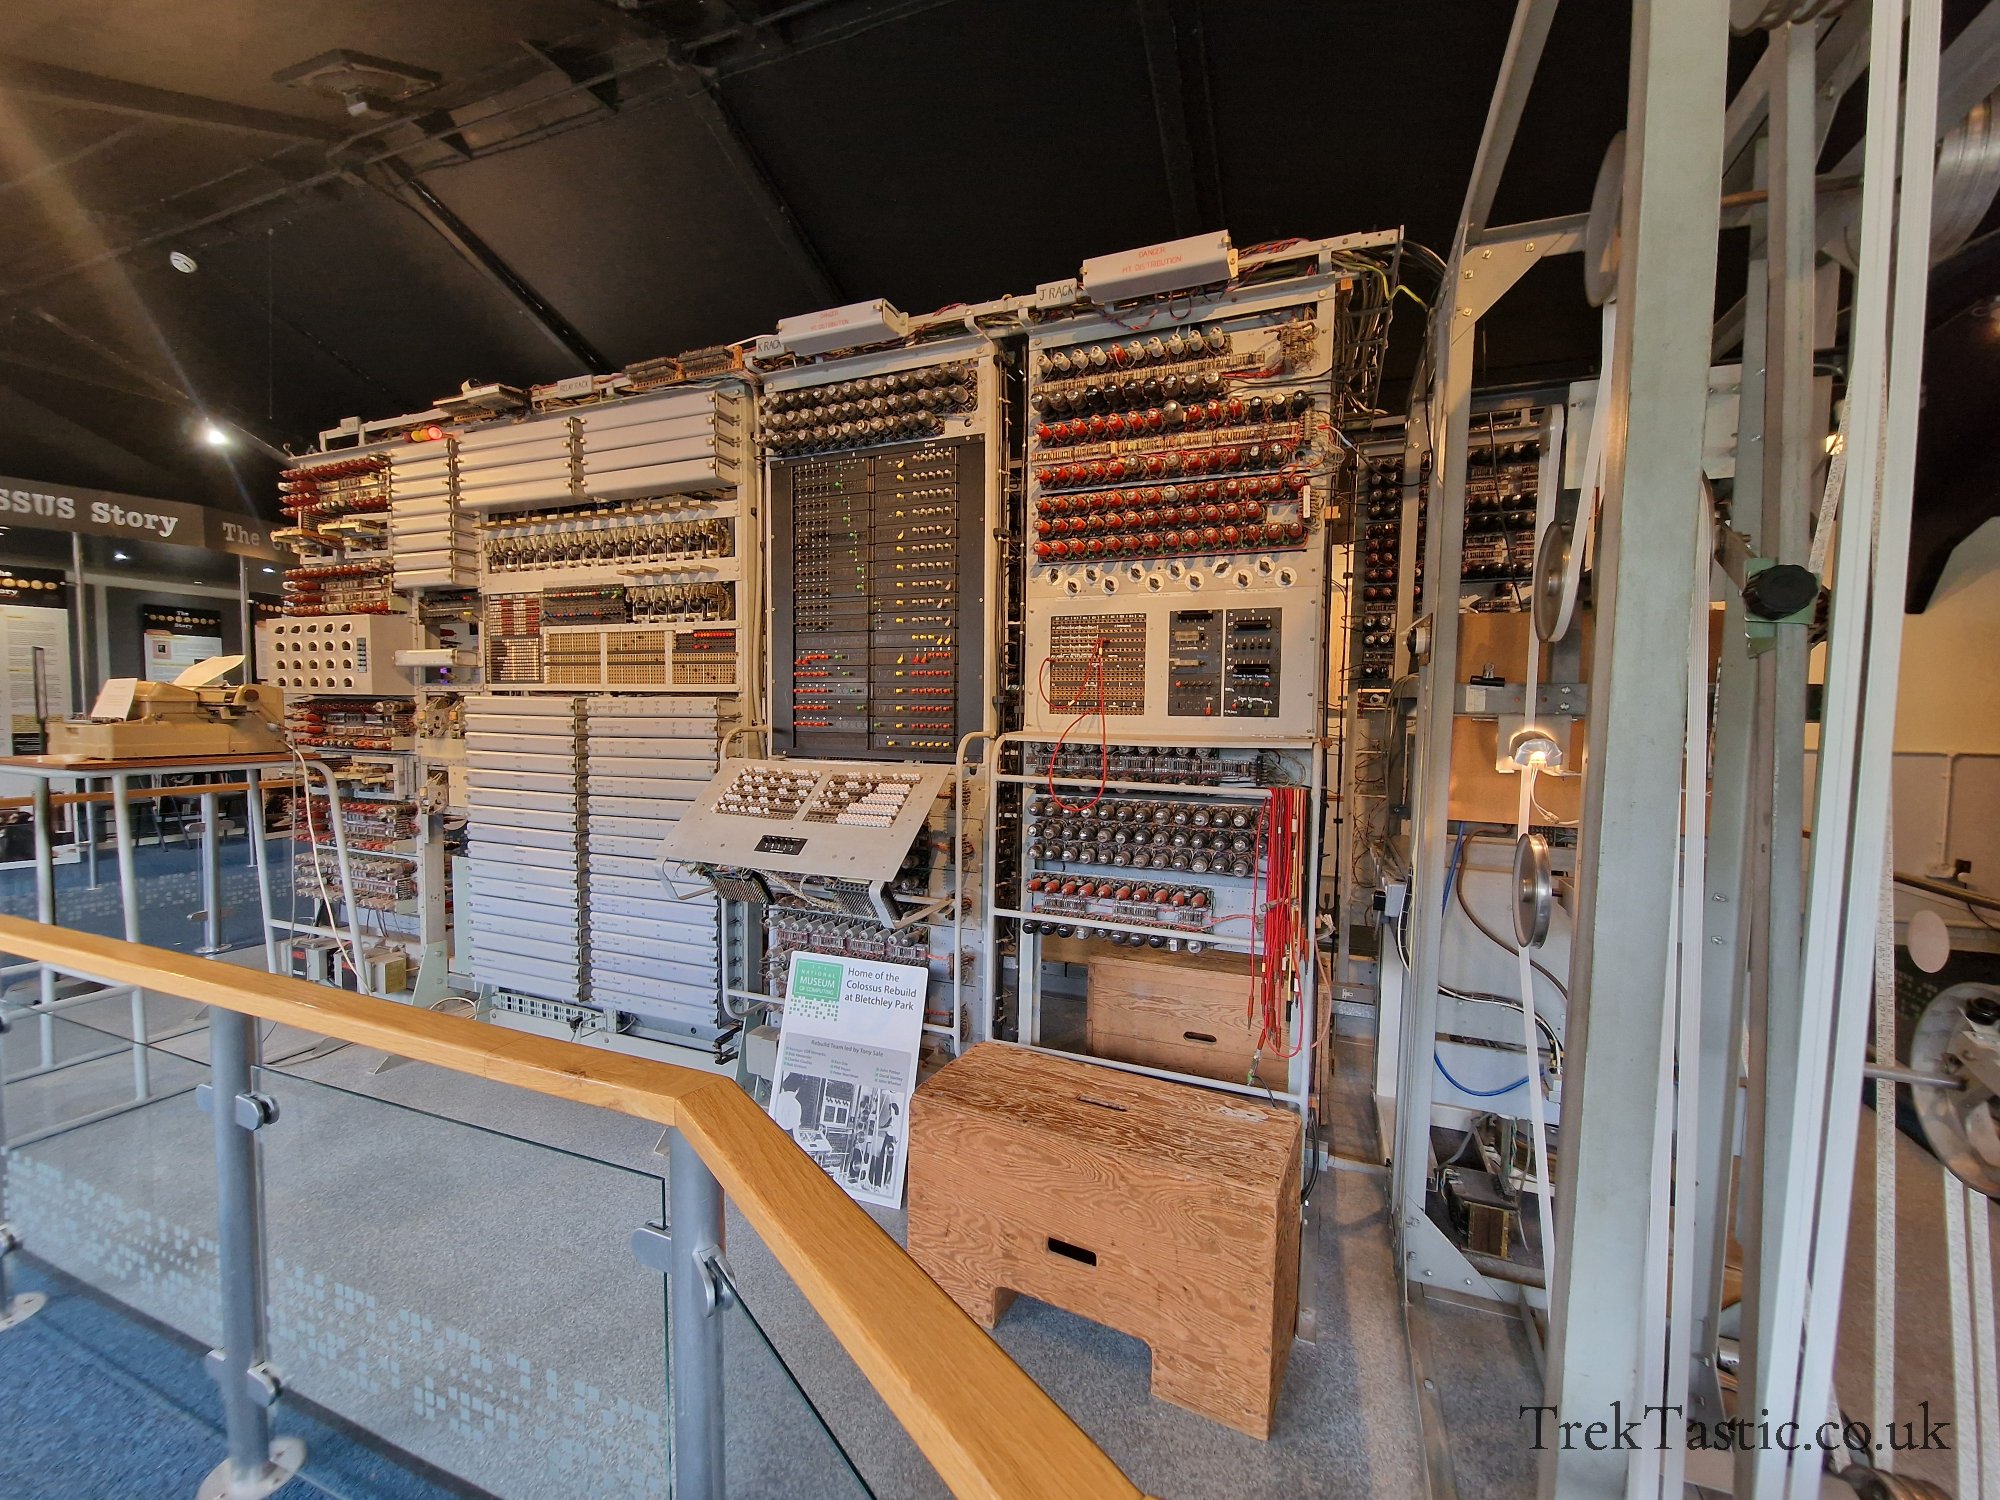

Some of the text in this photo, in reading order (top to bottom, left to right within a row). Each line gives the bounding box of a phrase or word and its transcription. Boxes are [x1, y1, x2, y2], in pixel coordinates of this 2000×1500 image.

[1138, 246, 1166, 258] DANGER
[1134, 255, 1182, 272] DISTRIBUTION
[1049, 284, 1075, 299] RACK
[90, 502, 179, 538] Story
[222, 522, 261, 546] The
[801, 968, 836, 979] NATIONAL
[848, 967, 900, 983] Home of the
[800, 976, 835, 989] MUSEUM
[846, 980, 917, 998] Colossus Rebuild
[855, 994, 893, 1009] Bletchley
[894, 999, 914, 1011] Park
